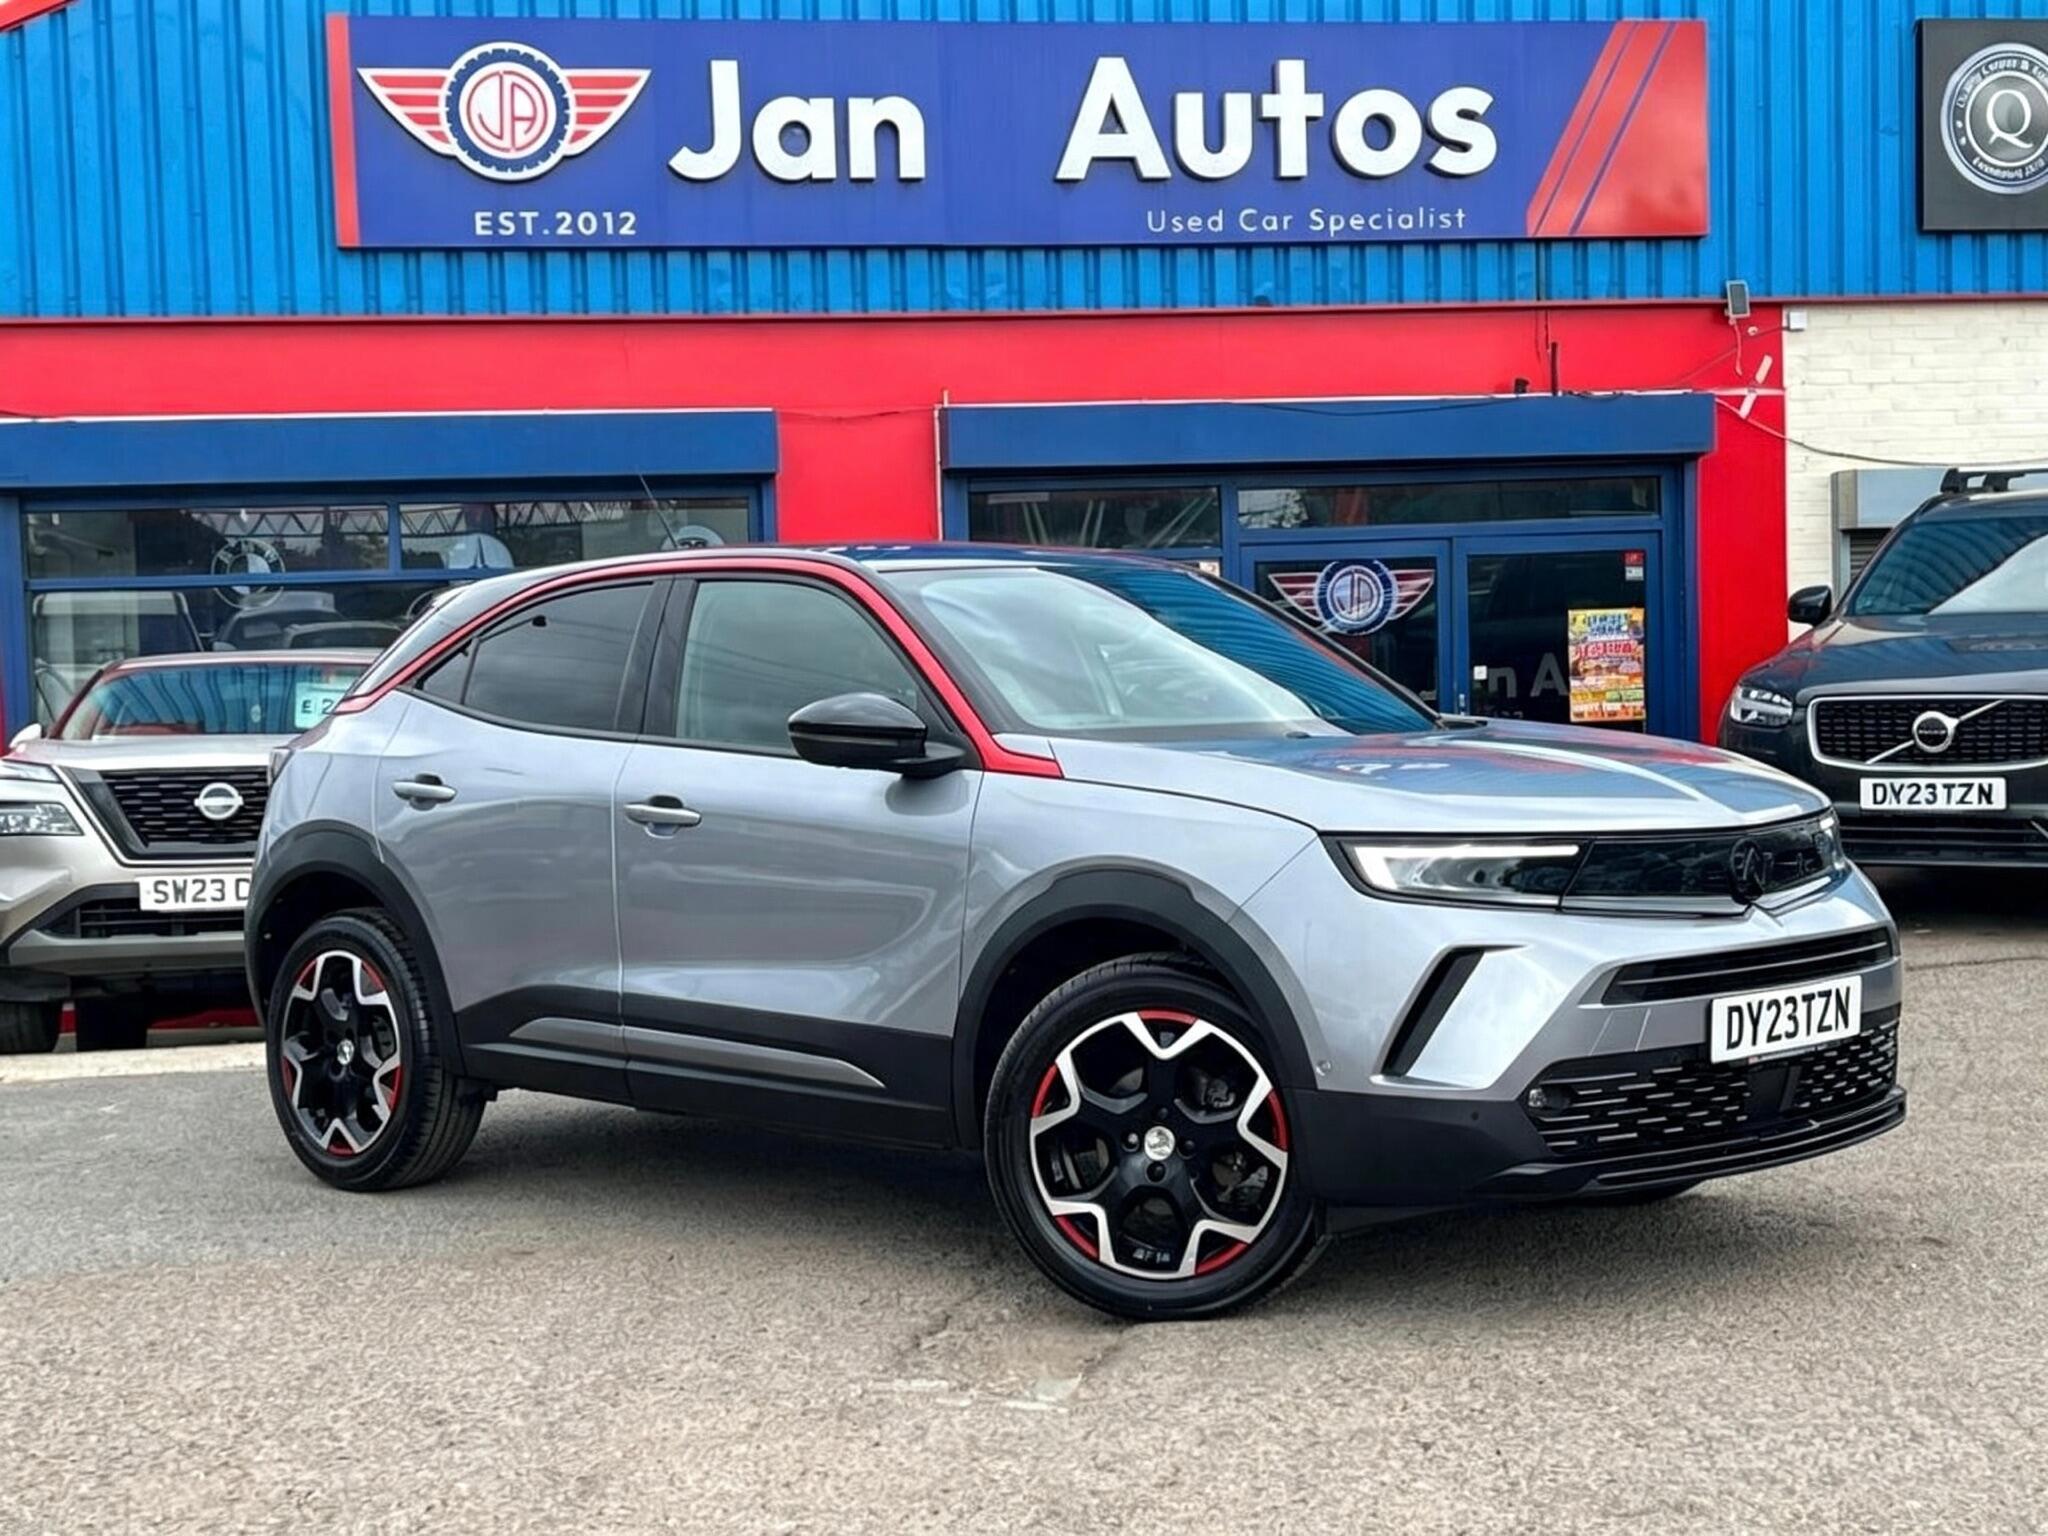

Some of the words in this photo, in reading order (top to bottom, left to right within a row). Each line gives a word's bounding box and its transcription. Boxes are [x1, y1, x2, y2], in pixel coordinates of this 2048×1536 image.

[668, 60, 927, 181] Jan
[1055, 56, 1498, 180] Autos
[1986, 89, 2033, 148] Q
[474, 211, 646, 236] EST.2012
[1147, 208, 1223, 233] Used
[1239, 209, 1293, 232] Car
[1309, 207, 1466, 237] Specialist
[1871, 782, 1994, 806] DY23TZN
[152, 877, 227, 904] SW23
[1726, 986, 1851, 1050] DY23TZN
